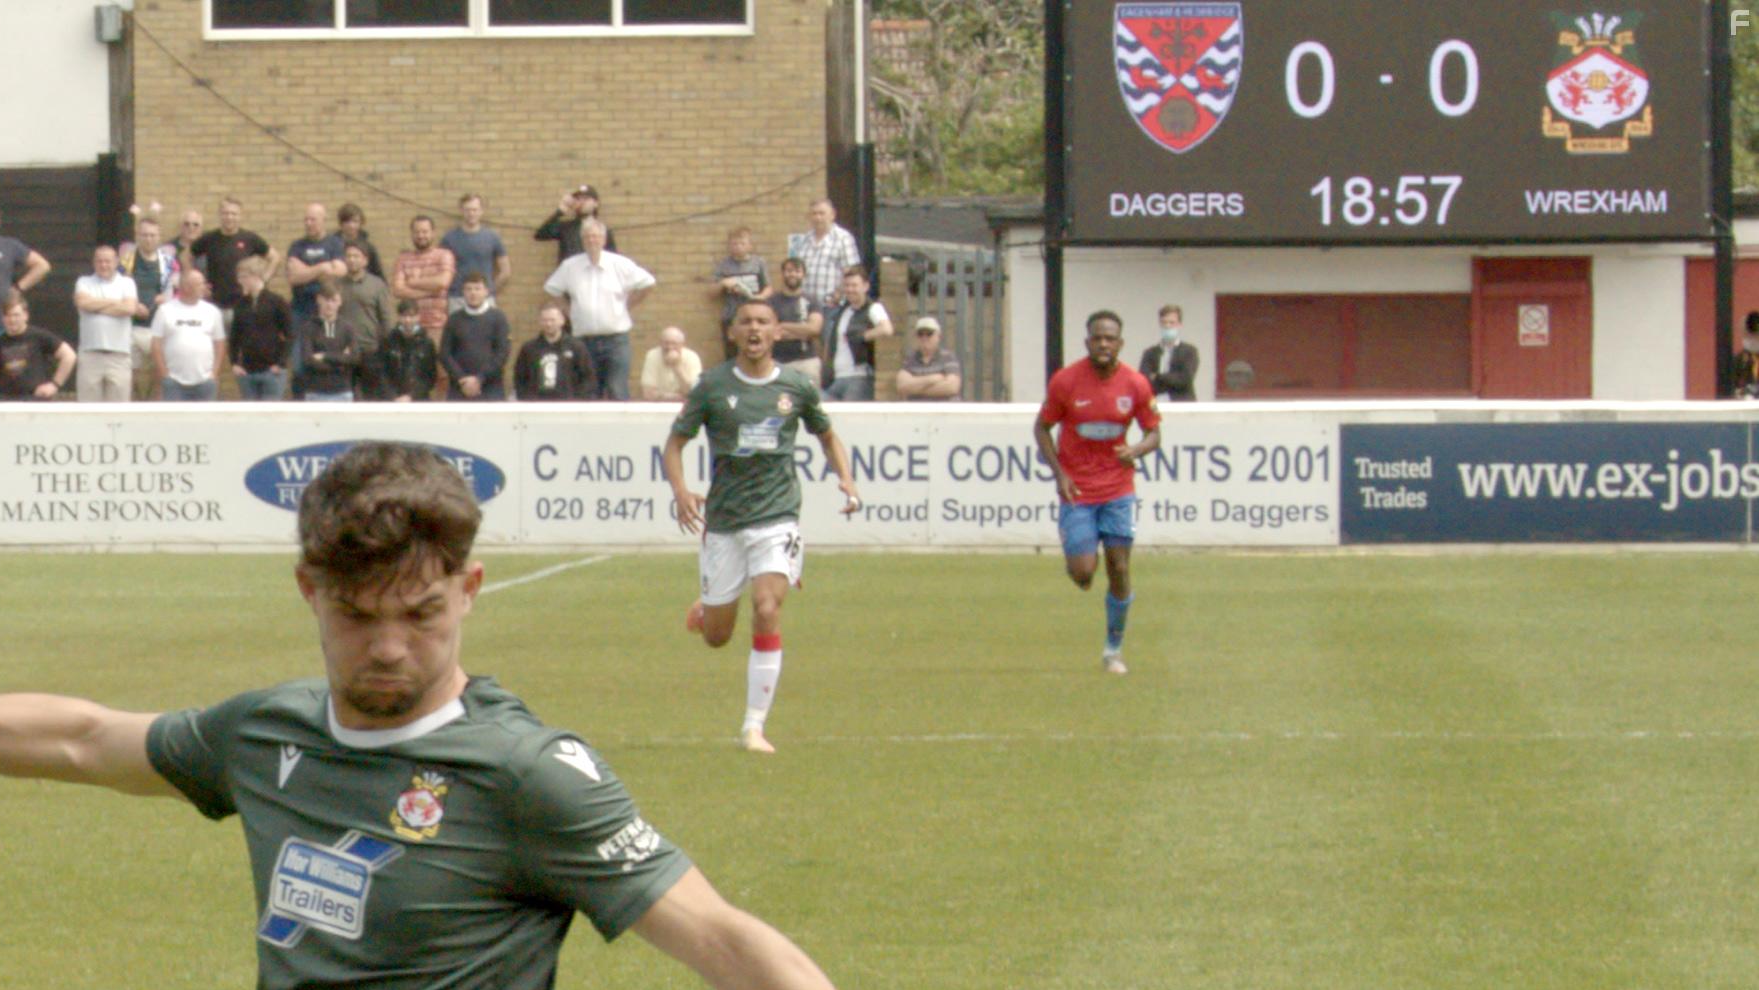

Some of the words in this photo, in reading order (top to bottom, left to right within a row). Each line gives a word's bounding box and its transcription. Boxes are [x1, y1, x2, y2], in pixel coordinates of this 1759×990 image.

[1285, 41, 1335, 118] 0
[1428, 39, 1479, 117] 0
[1110, 192, 1244, 216] DAGGERS
[1310, 175, 1463, 225] 18:57
[1525, 189, 1668, 214] WREXHAM
[14, 443, 118, 466] PROUD
[124, 443, 176, 466] TO
[179, 443, 211, 466] BE
[533, 444, 558, 483] C
[575, 455, 634, 482] AND
[1248, 445, 1330, 482] 2001
[1355, 456, 1433, 480] Trusted
[31, 471, 92, 494] THE
[97, 471, 194, 494] CLUB'S
[536, 497, 584, 521] 020
[595, 497, 655, 521] 8471
[1360, 486, 1428, 508] Trades
[0, 500, 81, 523] MAIN
[86, 500, 225, 523] SPONSOR
[942, 497, 1061, 526] Support
[1153, 497, 1201, 522] the
[1211, 497, 1330, 527] Daggers
[279, 879, 355, 924] Trailers
